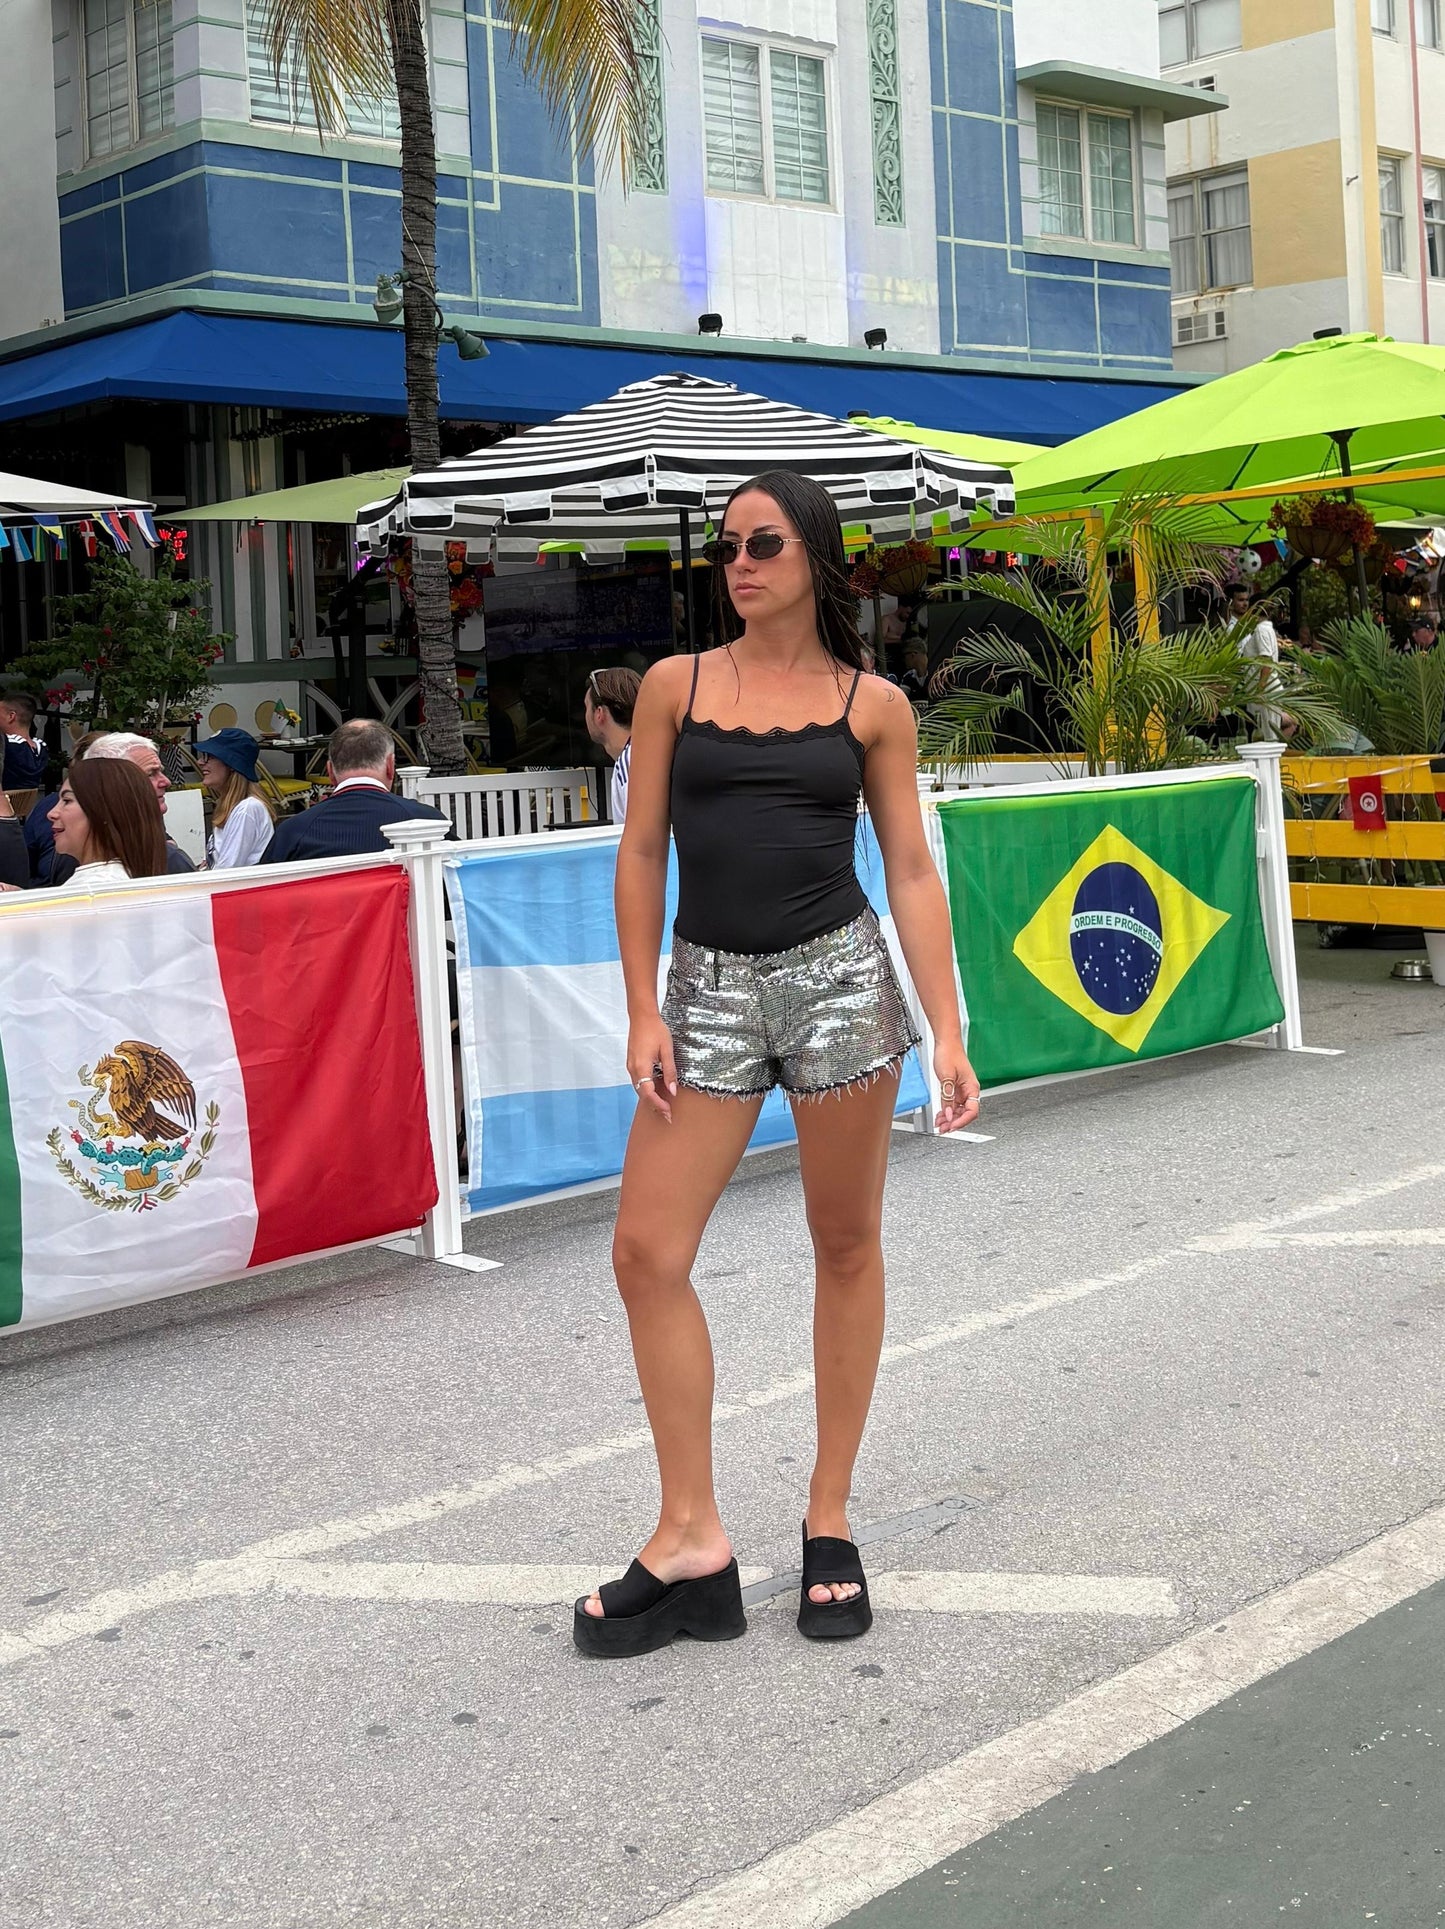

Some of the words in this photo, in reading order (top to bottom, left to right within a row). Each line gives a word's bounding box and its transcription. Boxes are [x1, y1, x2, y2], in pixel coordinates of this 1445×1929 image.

[1074, 915, 1103, 929] ORDEM
[1106, 915, 1112, 926] E
[1114, 916, 1161, 950] PROGRESSO
